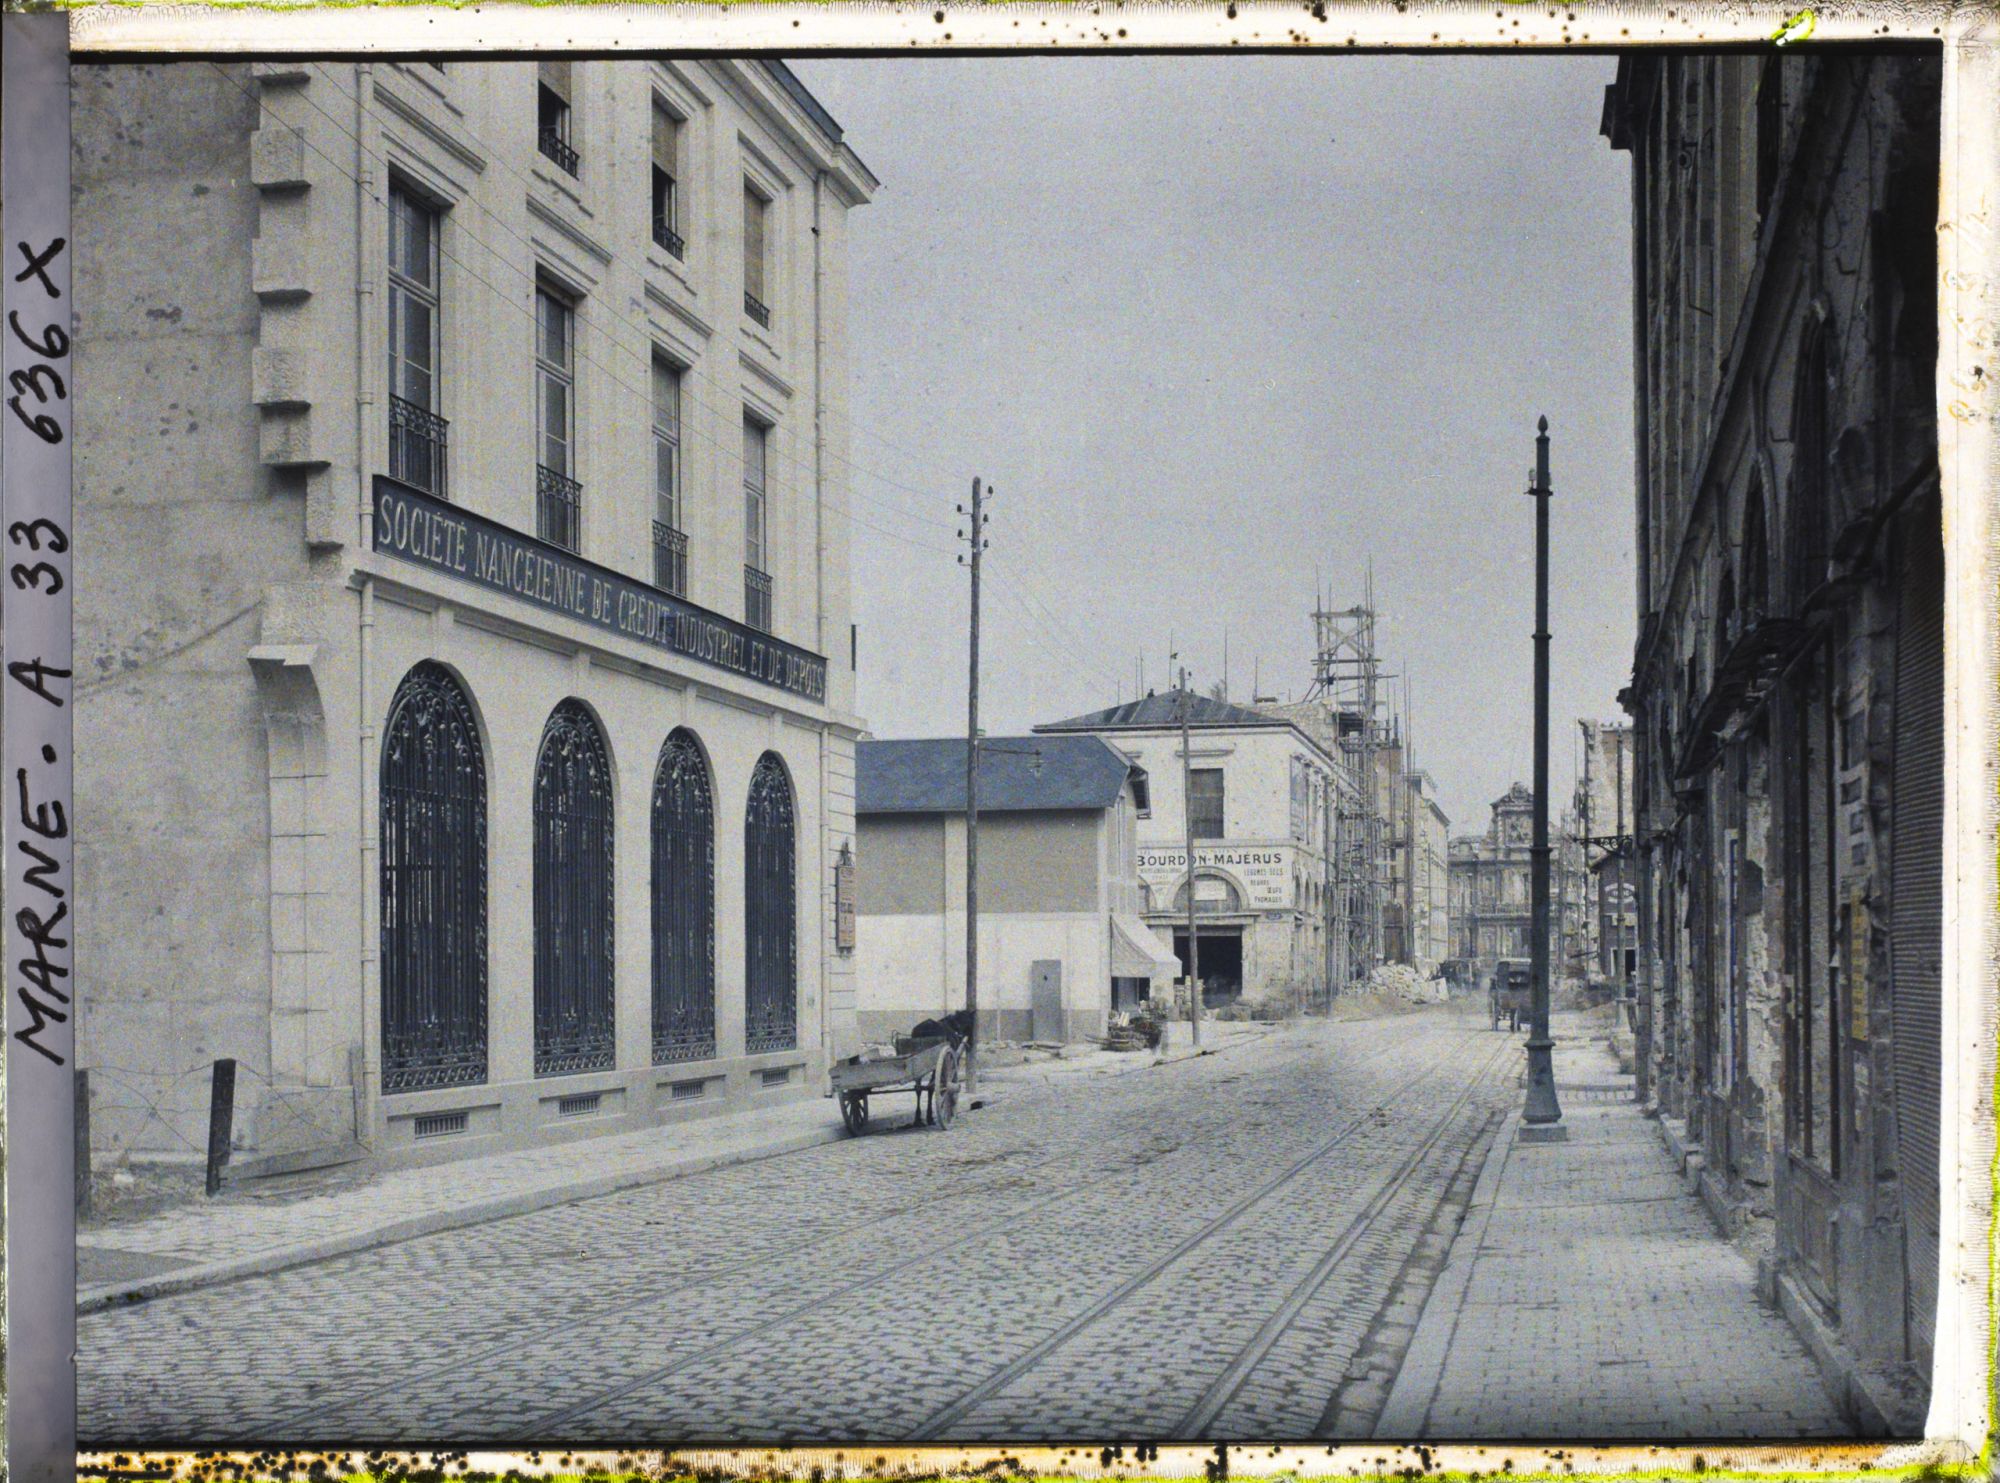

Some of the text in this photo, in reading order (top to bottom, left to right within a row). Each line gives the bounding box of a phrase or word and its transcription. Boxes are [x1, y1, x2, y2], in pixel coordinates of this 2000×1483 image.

[15, 237, 66, 299] X
[9, 310, 70, 444] 636
[9, 518, 69, 596] 33
[379, 494, 468, 572] SOCIÉTÉ
[474, 531, 586, 614] NANCÉIENNE
[591, 578, 612, 623] DE
[618, 590, 670, 644] CRÉDIT
[675, 611, 747, 672] INDUSTRIEL
[751, 640, 765, 678] ET
[768, 647, 783, 684] DE
[8, 656, 72, 707] A
